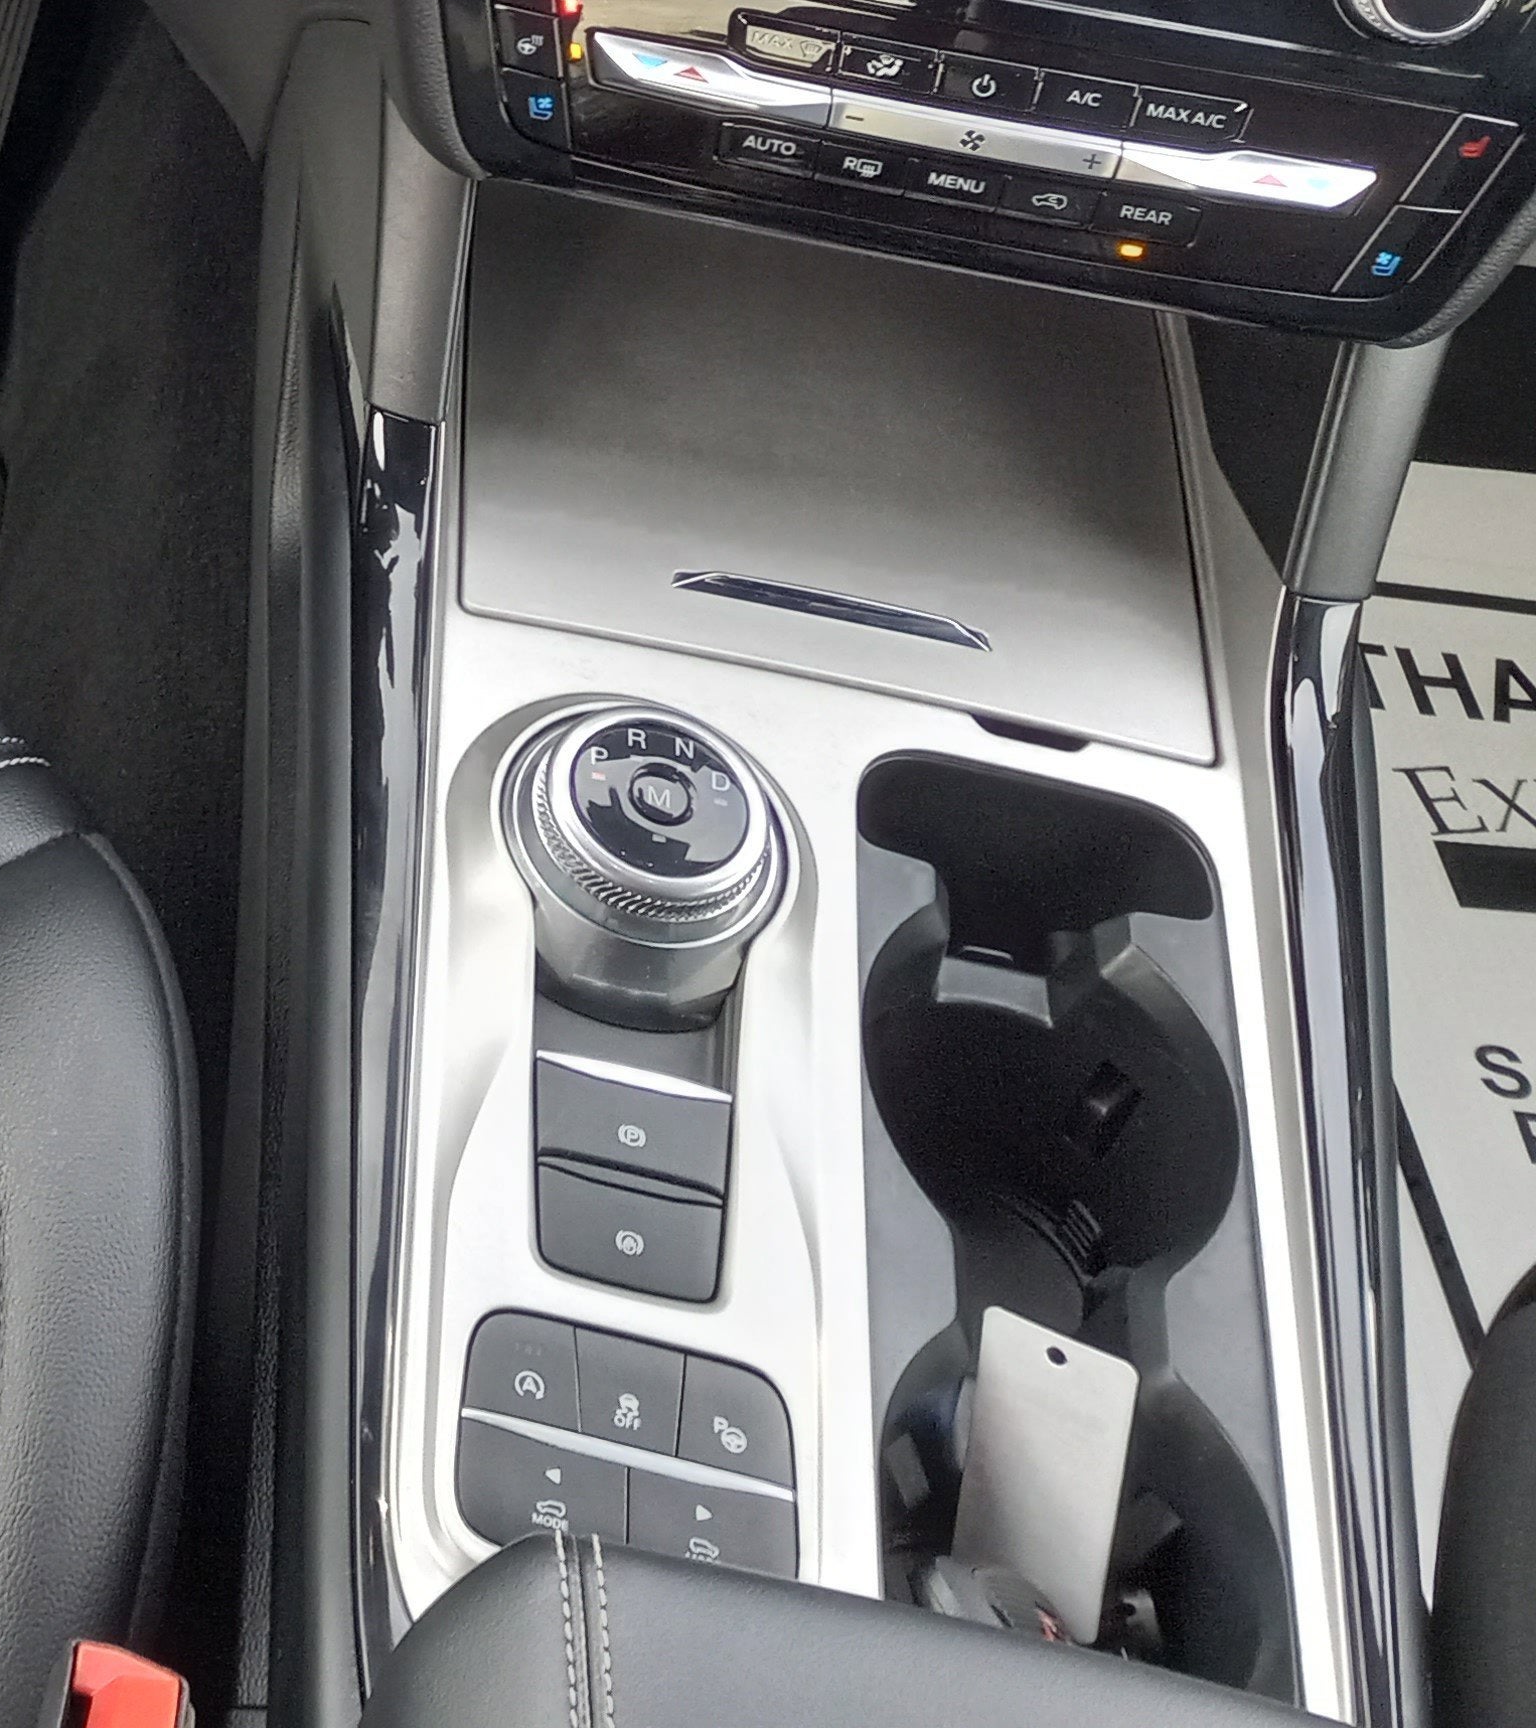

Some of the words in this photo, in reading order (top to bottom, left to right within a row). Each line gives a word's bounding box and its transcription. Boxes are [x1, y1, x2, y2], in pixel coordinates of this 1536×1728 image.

[750, 29, 794, 51] MAX
[1065, 89, 1104, 108] A/C
[1145, 102, 1191, 124] MAX
[1189, 110, 1228, 130] A/C
[742, 134, 797, 157] AUTO
[927, 171, 986, 195] MENU
[1118, 203, 1173, 226] REAR
[590, 746, 609, 765] P
[627, 728, 647, 750] R
[674, 737, 696, 760] N
[711, 771, 731, 792] D
[647, 784, 671, 808] M
[613, 1413, 641, 1430] OFF
